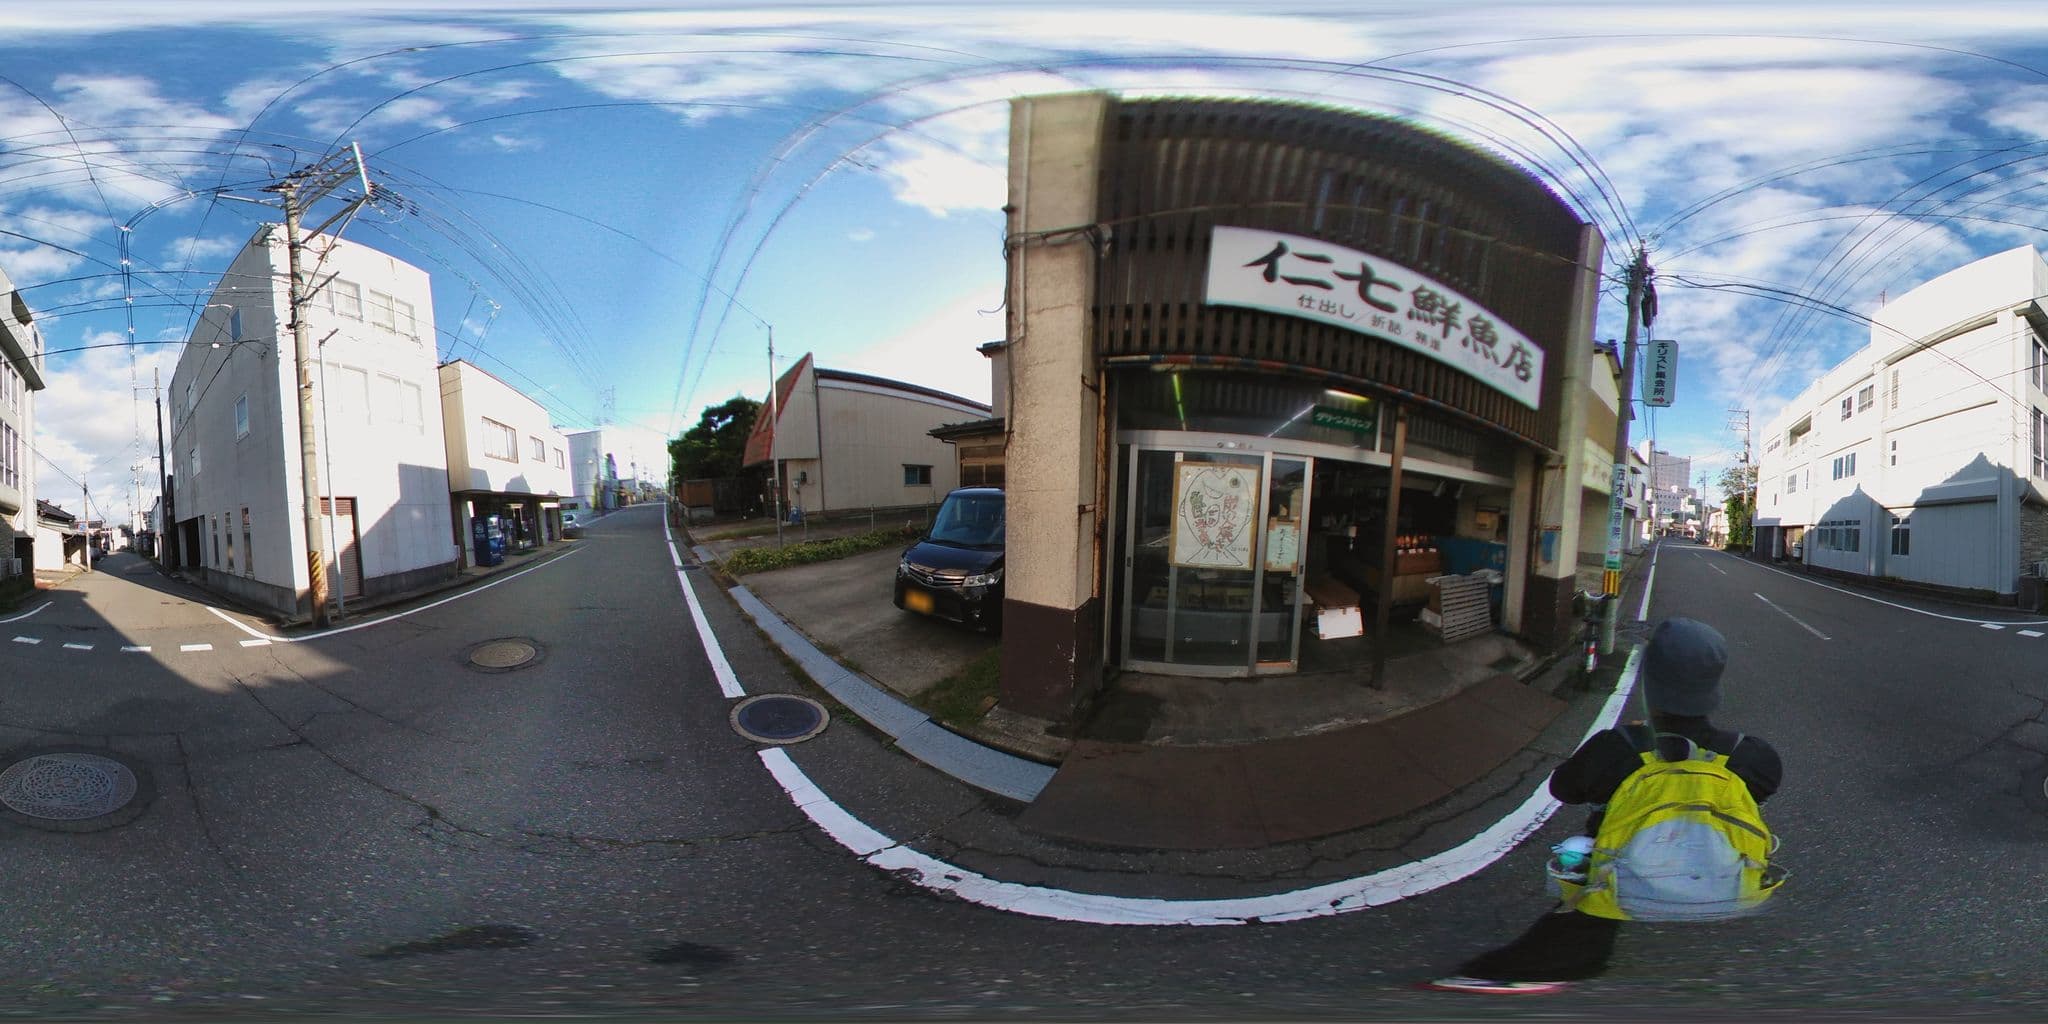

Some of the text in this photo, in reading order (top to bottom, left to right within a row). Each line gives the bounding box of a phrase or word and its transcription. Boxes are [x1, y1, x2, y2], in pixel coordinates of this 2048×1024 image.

[1243, 240, 1534, 383] 仁七鮮魚店
[1653, 342, 1669, 396] キリスト集会所
